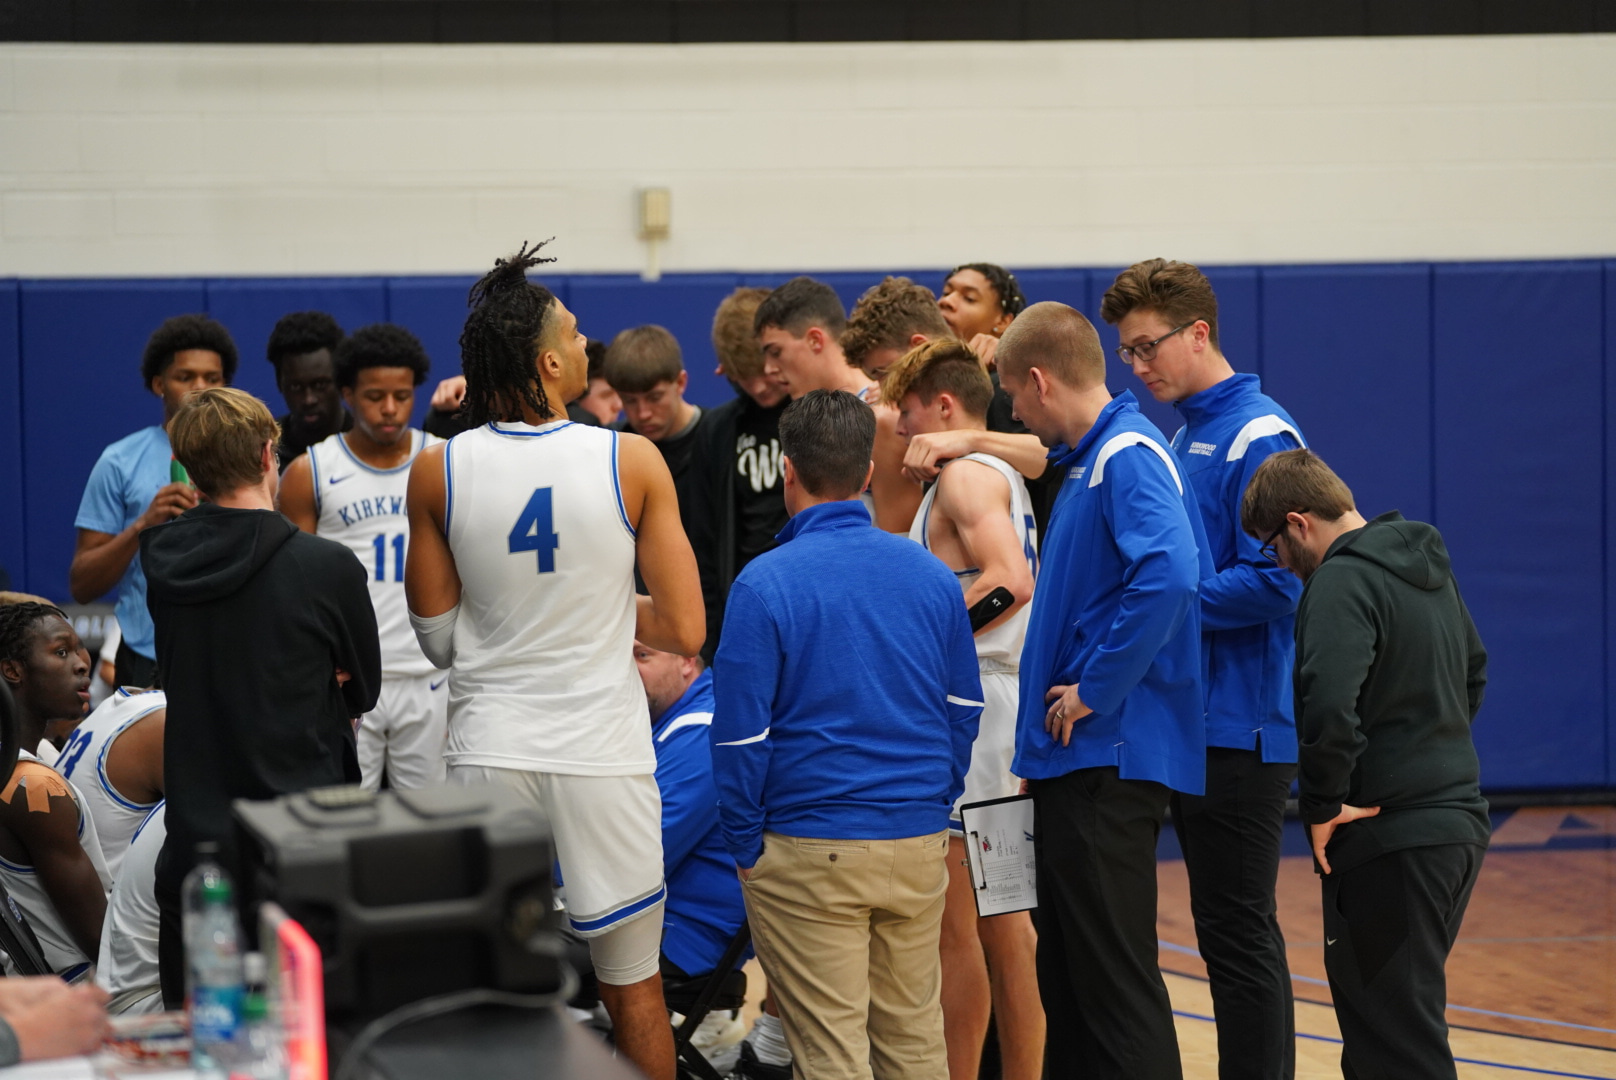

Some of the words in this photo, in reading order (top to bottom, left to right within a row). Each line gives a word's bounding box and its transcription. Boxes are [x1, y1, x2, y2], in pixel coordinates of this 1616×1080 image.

[338, 495, 407, 527] KIRKW
[507, 485, 560, 575] 4
[373, 533, 405, 582] 11
[991, 598, 1003, 607] KT
